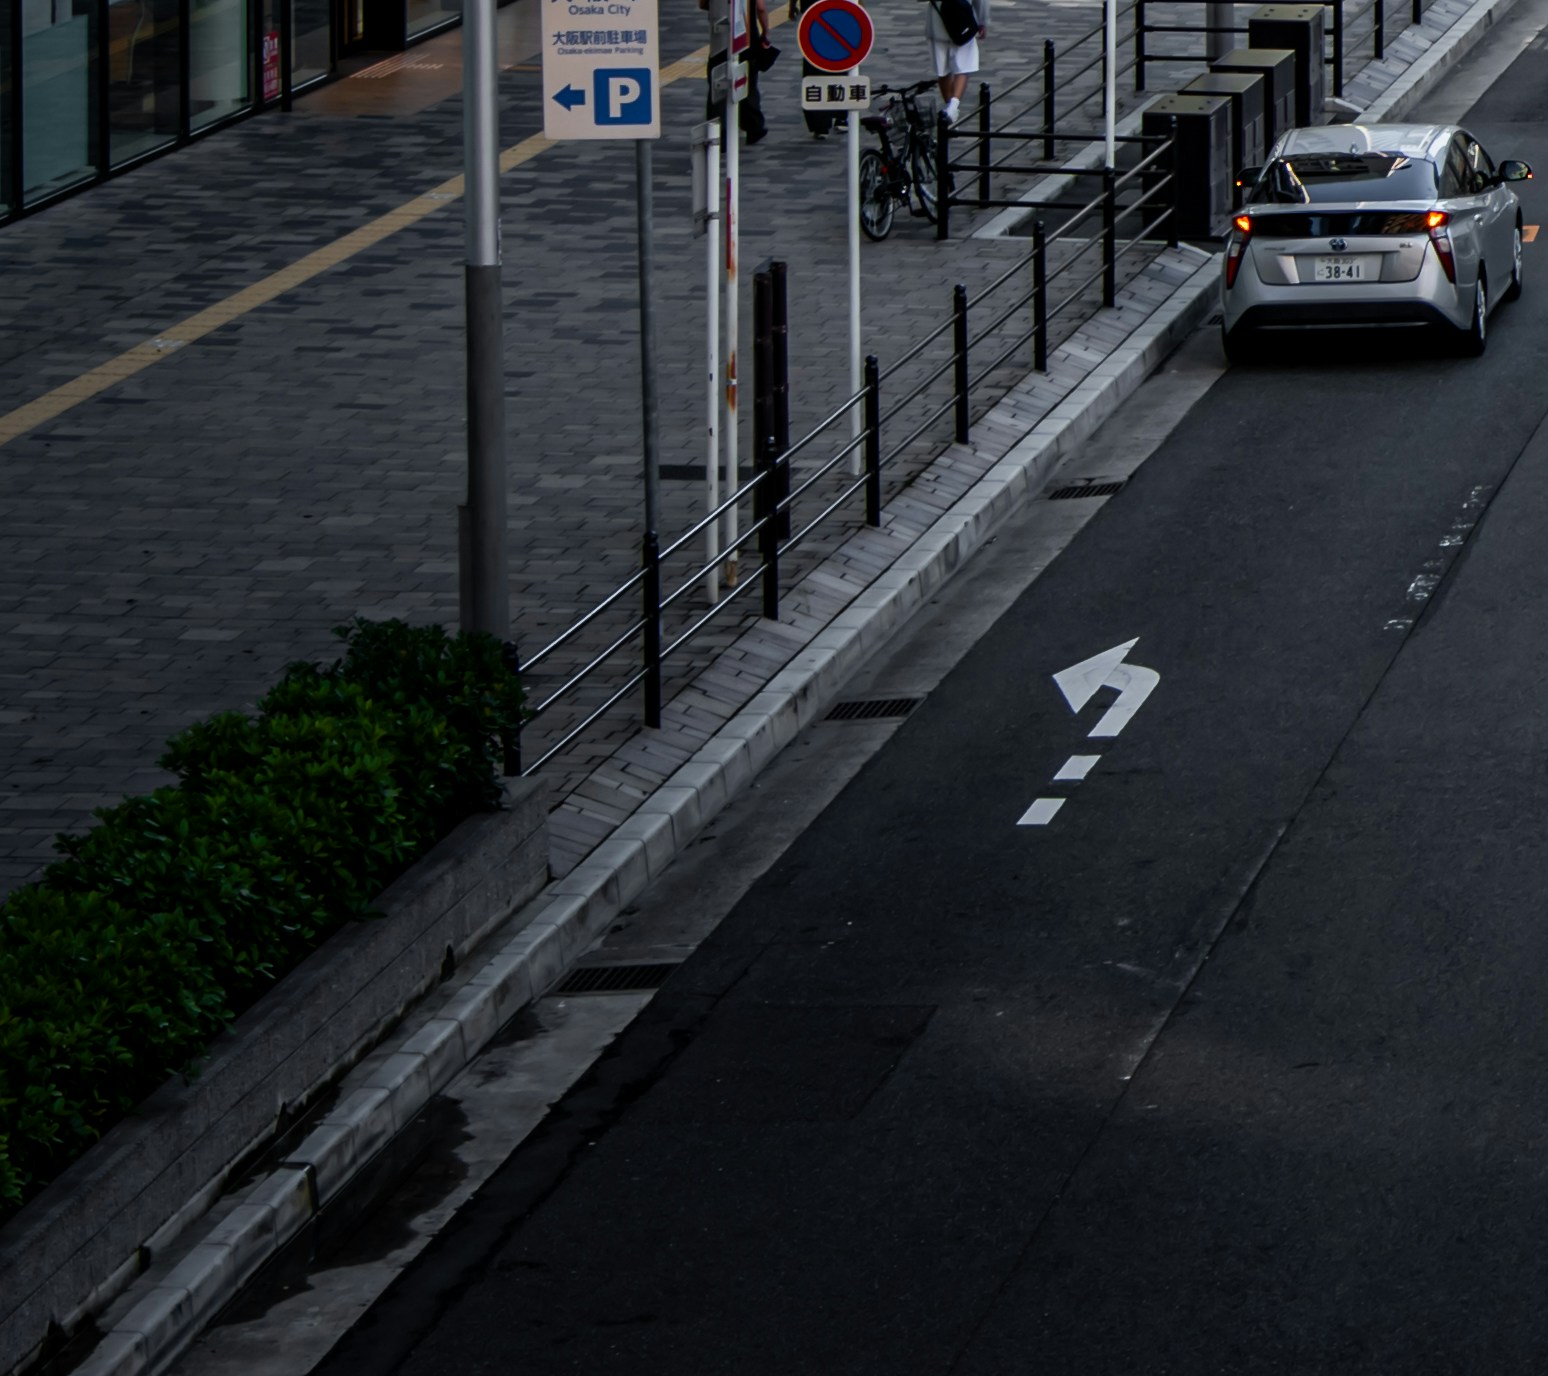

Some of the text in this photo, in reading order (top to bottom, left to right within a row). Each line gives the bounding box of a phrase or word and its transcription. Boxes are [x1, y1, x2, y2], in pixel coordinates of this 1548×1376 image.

[568, 4, 632, 17] Osaka City
[552, 29, 648, 47] 大阪駅前駐車場
[608, 77, 641, 118] P
[804, 84, 868, 103] 自動車
